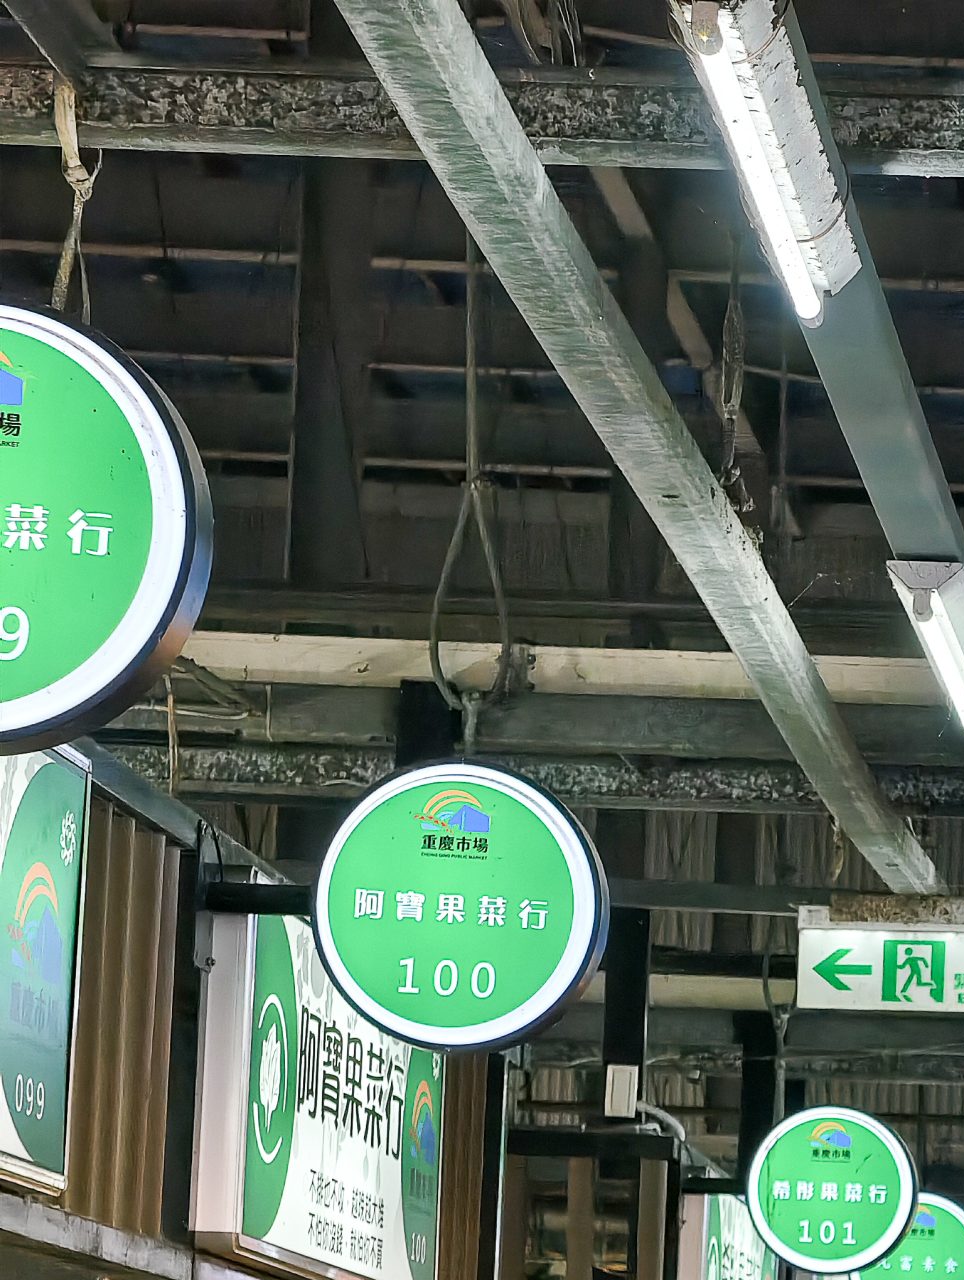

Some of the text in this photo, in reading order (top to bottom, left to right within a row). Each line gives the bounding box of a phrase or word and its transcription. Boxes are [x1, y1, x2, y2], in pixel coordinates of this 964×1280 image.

[0, 412, 22, 437] 場
[3, 503, 113, 556] 菜行
[421, 834, 488, 854] 重慶市場
[353, 888, 549, 930] 阿寶果菜行
[397, 956, 497, 999] 100
[15, 1072, 46, 1121] 099
[297, 1004, 405, 1160] 阿寶果菜行
[410, 1232, 427, 1265] 100
[798, 1219, 857, 1245] 101
